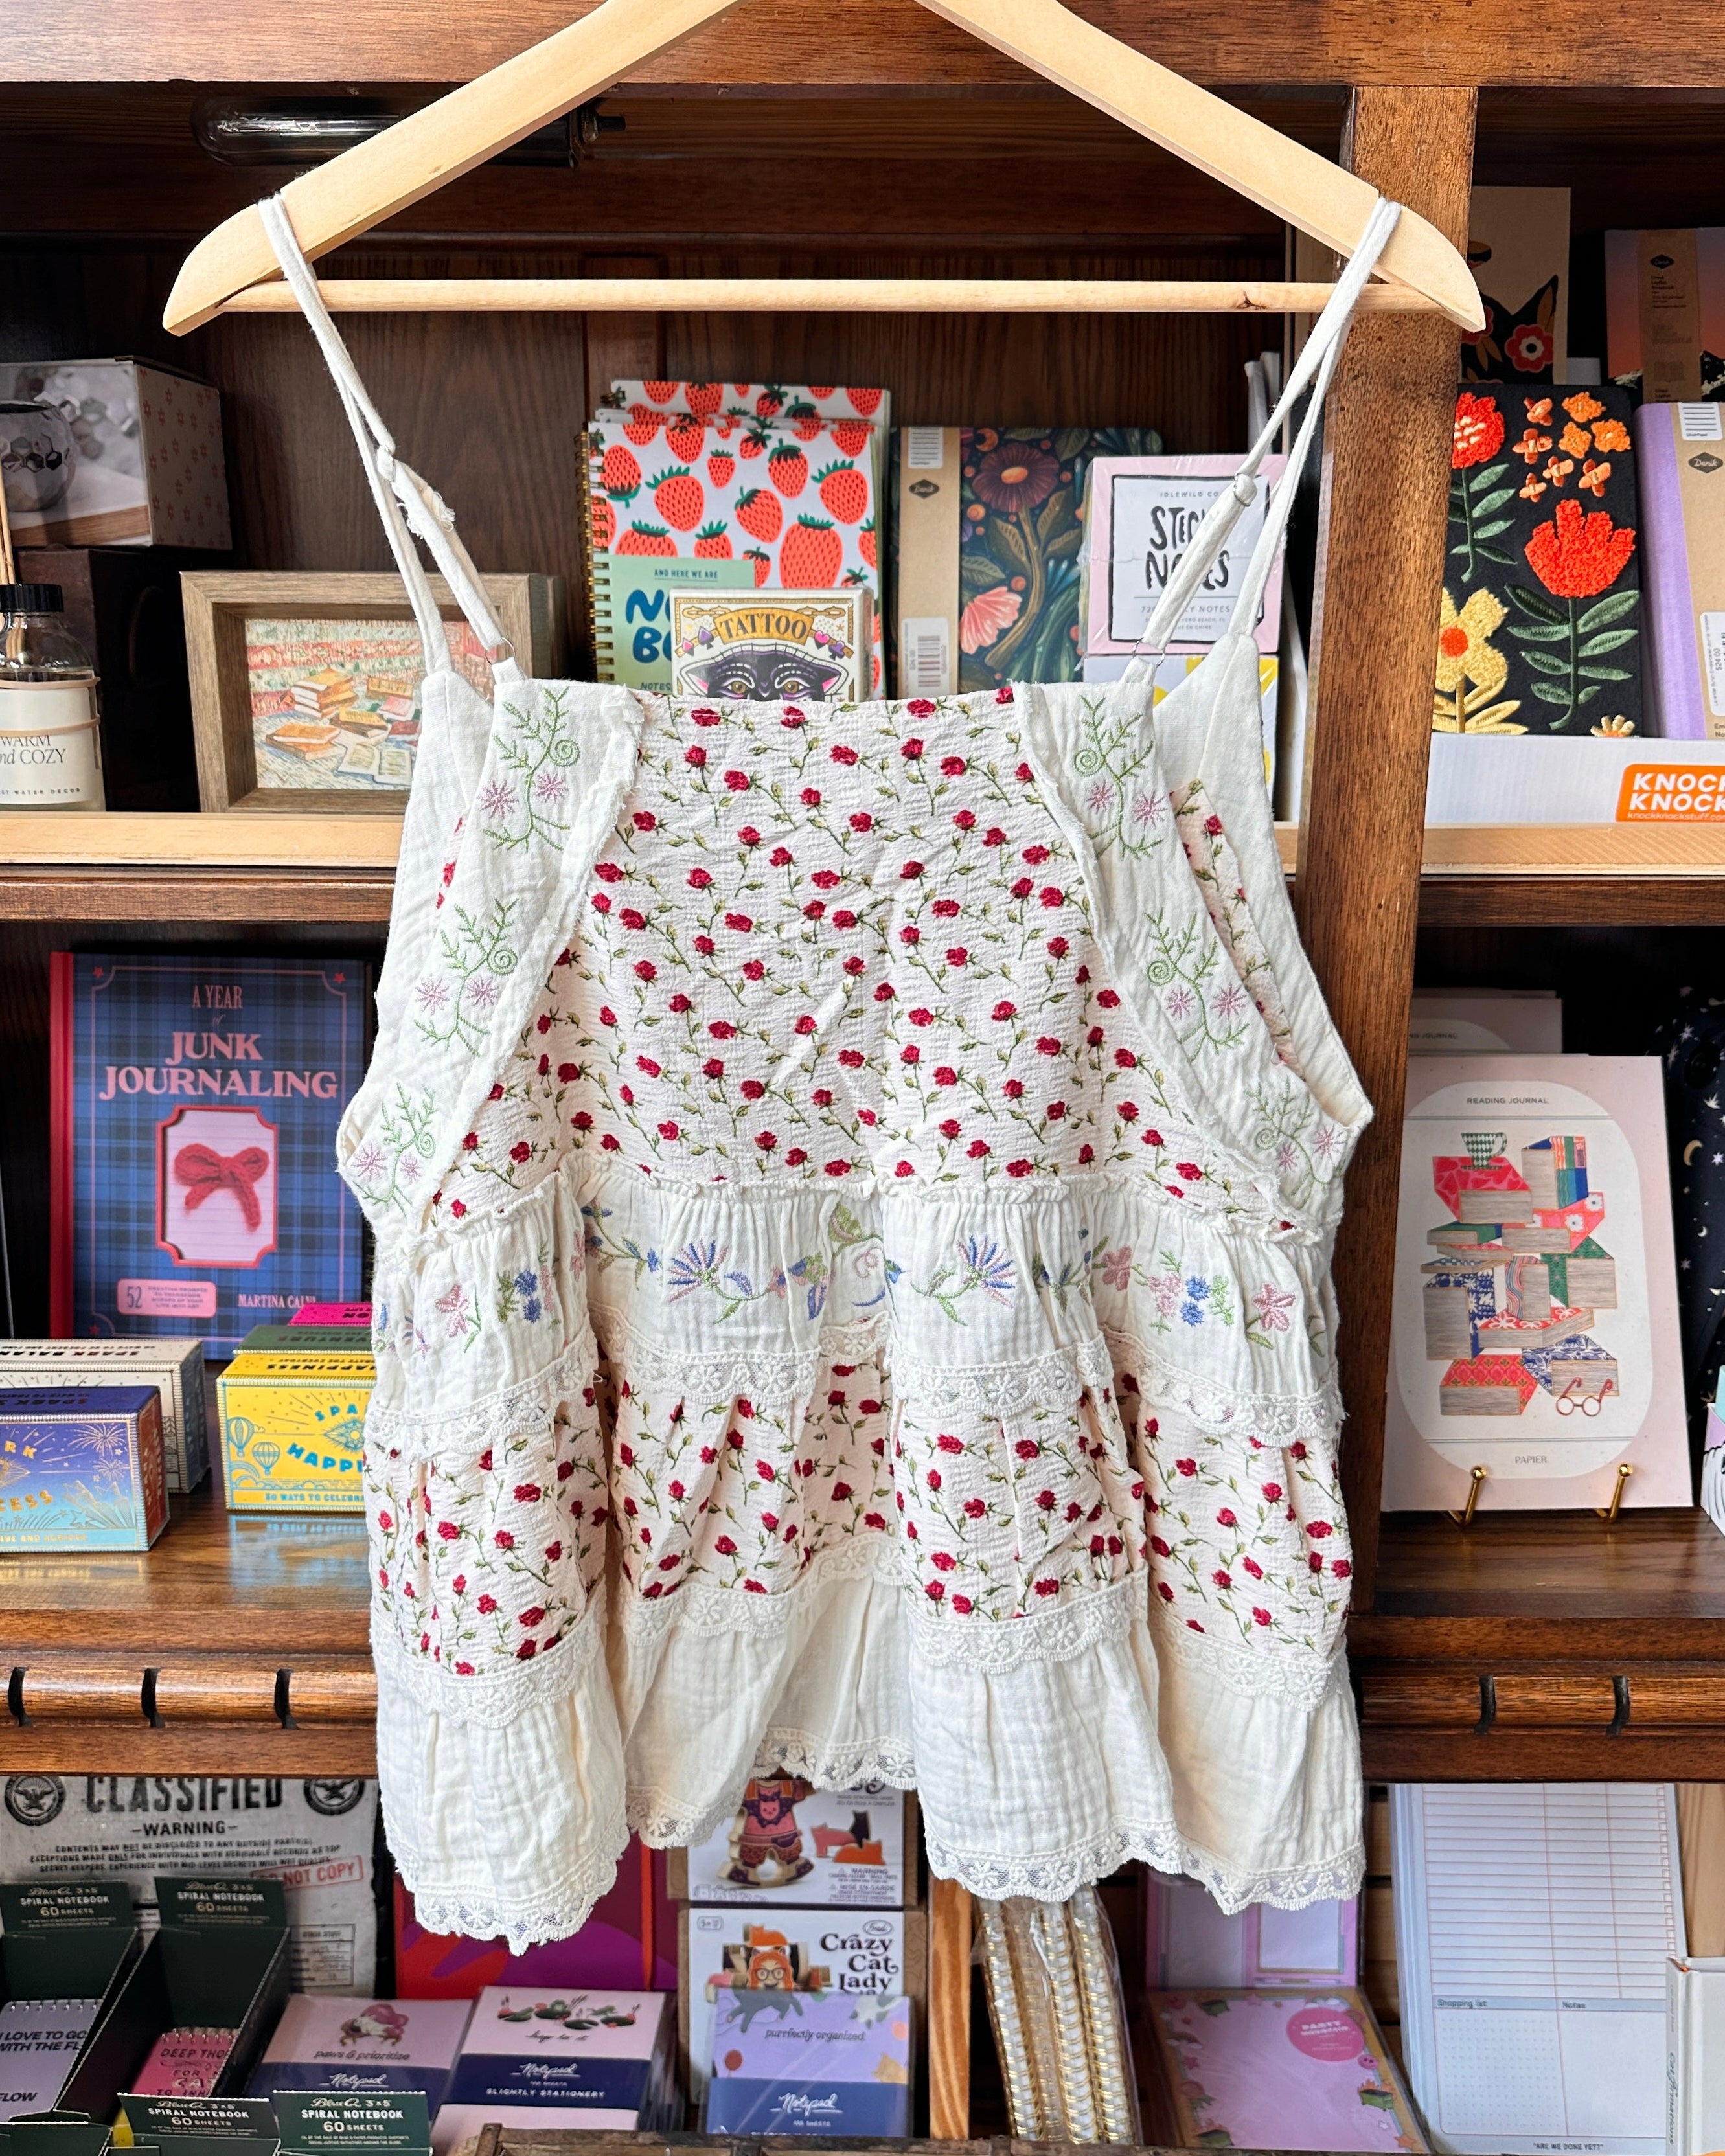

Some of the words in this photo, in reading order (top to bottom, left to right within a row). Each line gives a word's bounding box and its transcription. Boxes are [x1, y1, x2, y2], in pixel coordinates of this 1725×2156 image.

[1693, 457, 1719, 467] Denik
[692, 570, 702, 578] WE
[705, 571, 718, 579] ARE
[719, 613, 806, 639] TATTOO
[1, 735, 51, 747] WARM
[0, 749, 15, 764] nd
[20, 749, 66, 764] COZY
[192, 985, 201, 1008] A
[205, 984, 244, 1009] YEAR
[166, 1032, 264, 1065] JUNK
[99, 1066, 338, 1100] JOURNALING
[127, 1286, 142, 1309] 52
[238, 1294, 285, 1308] MARTINA
[314, 1403, 358, 1422] SPA
[286, 1442, 363, 1473] HAPPI
[1515, 1455, 1547, 1464] PAPIER
[87, 1776, 282, 1813] CLASSIFIED
[30, 1854, 79, 1863] EXCEPTIONS
[108, 1853, 128, 1861] ONLY
[203, 1850, 223, 1858] WITH
[109, 1862, 155, 1870] EXPERIENCE
[284, 1868, 311, 1885] NOT
[317, 1862, 355, 1881] COPY
[20, 1897, 54, 1906] SPIRAL
[57, 1896, 109, 1905] NOTEBOOK
[177, 1891, 211, 1901] SPIRAL
[212, 1892, 265, 1902] NOTEBOOK
[40, 1906, 60, 1917] 60
[196, 1901, 214, 1912] 60
[820, 1933, 893, 1957] Crazy
[848, 1954, 899, 1975] Cat
[1437, 1999, 1472, 2008] Shopping
[1475, 1999, 1487, 2007] list
[1562, 2001, 1586, 2009] Notes
[5, 2031, 43, 2041] LOVE
[45, 2031, 64, 2040] TO
[764, 2028, 814, 2041] purrfectly
[816, 2030, 865, 2042] organized
[0, 2043, 32, 2052] WITH
[36, 2041, 63, 2051] THE
[161, 2048, 196, 2058] DEEP
[314, 2050, 345, 2059] paws
[520, 2062, 578, 2080] Notepad
[328, 2072, 388, 2089] Notepad
[486, 2087, 536, 2096] SLIGHTLY
[540, 2089, 606, 2098] STATIONERY
[778, 2093, 838, 2116] Notepad
[148, 2107, 187, 2116] SPIRAL
[190, 2110, 249, 2118] NOTEBOOK
[301, 2109, 341, 2119] SPIRAL
[343, 2109, 404, 2120] NOTEBOOK
[172, 2116, 192, 2126] 60
[323, 2120, 345, 2132] 60
